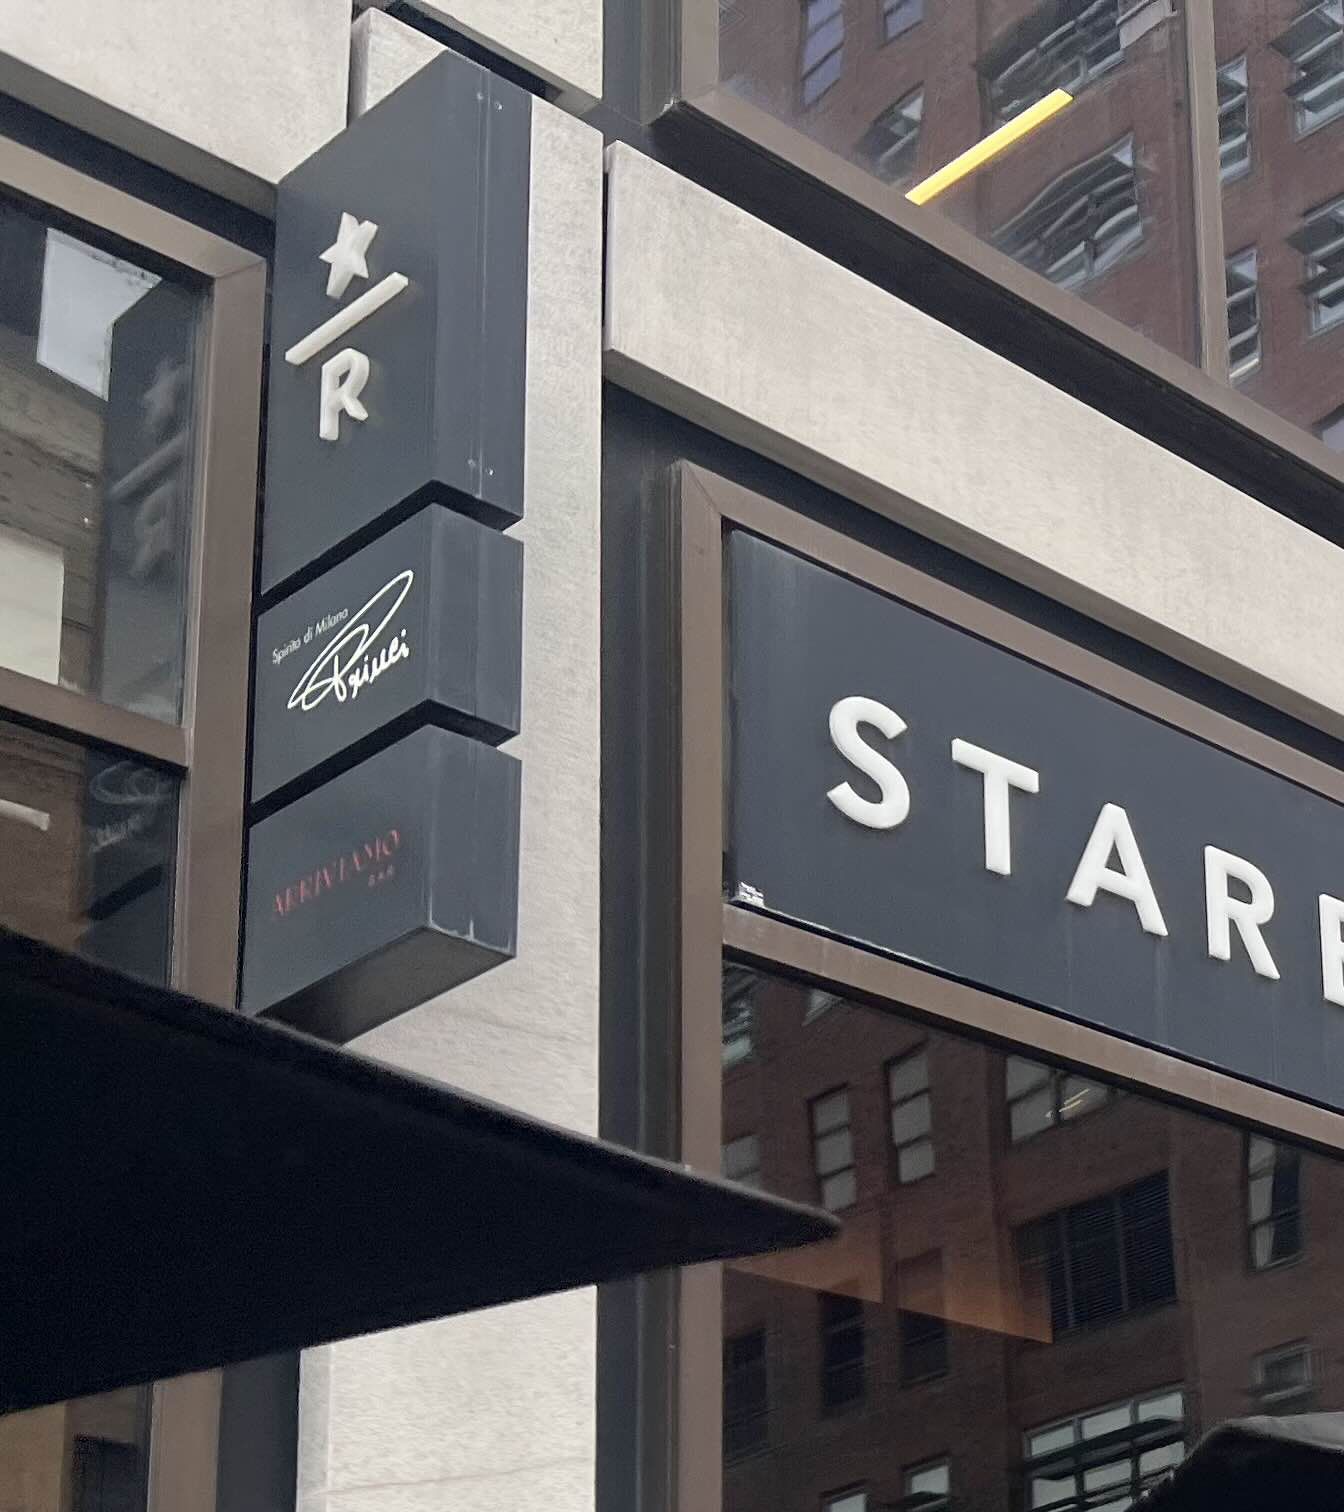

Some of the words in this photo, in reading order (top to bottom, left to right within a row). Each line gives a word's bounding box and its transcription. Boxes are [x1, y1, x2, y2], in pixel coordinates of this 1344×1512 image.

[319, 347, 370, 441] R
[272, 639, 301, 665] Spirito
[303, 626, 313, 644] di
[315, 608, 349, 637] Milano
